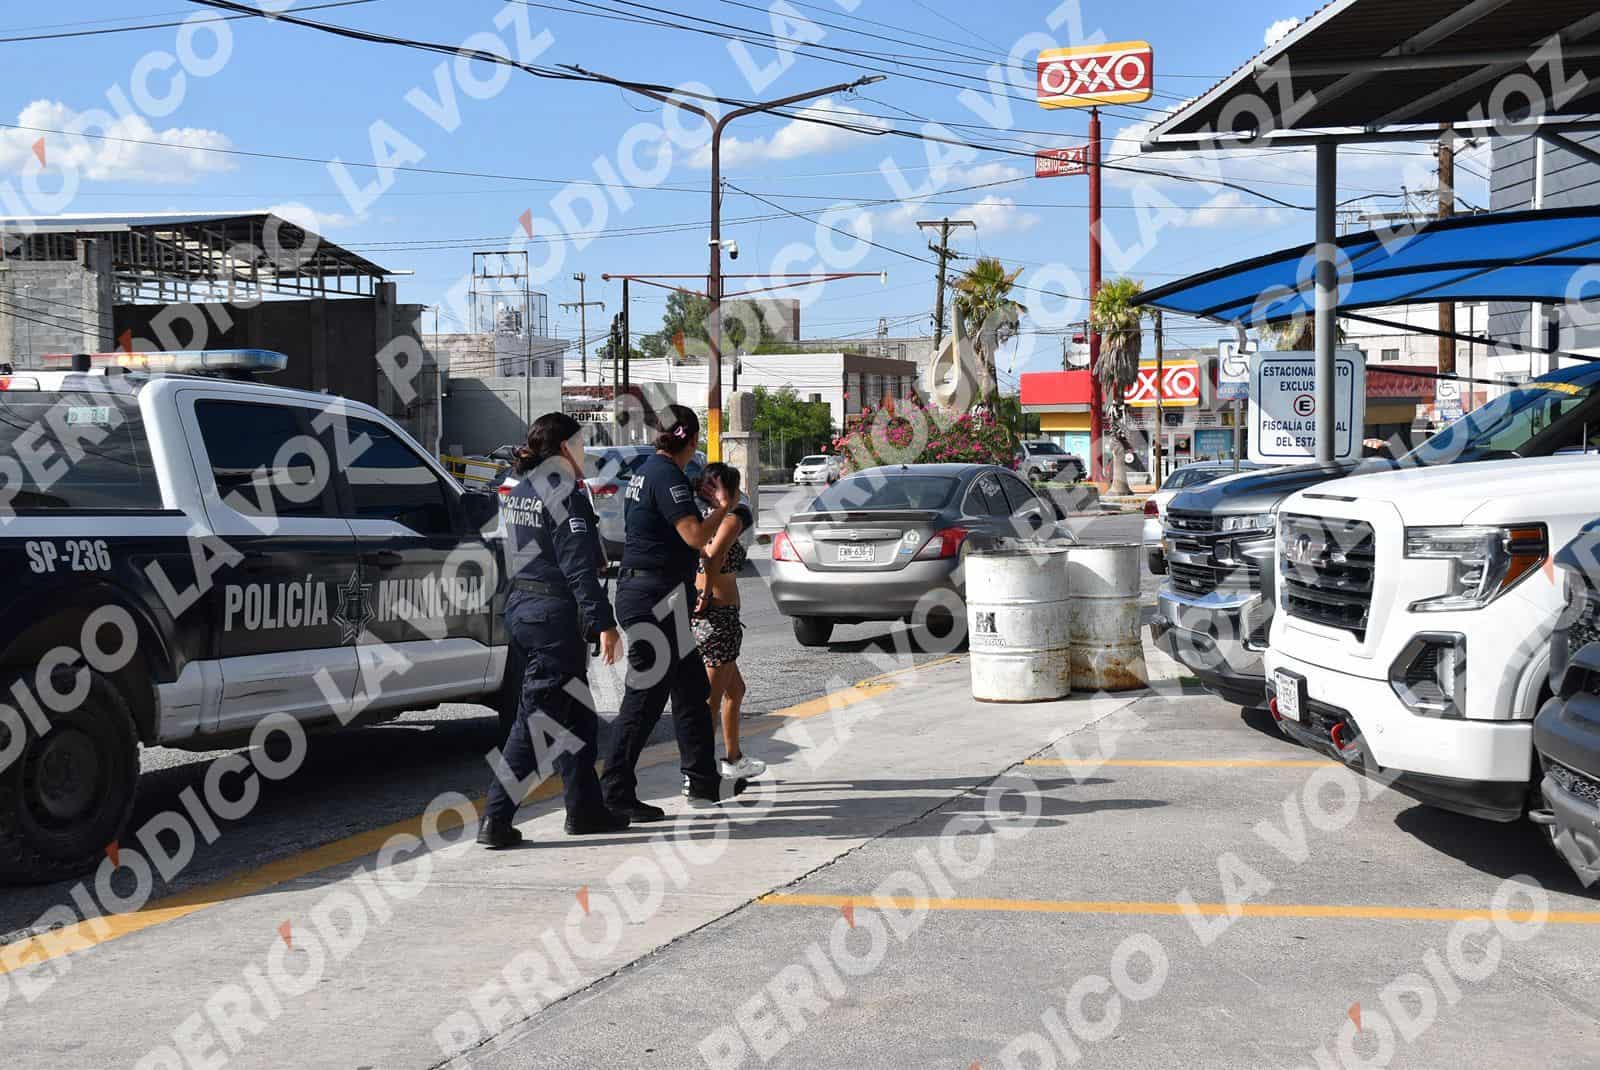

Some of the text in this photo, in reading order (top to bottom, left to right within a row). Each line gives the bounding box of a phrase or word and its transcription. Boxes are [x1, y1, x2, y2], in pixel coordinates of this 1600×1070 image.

[1041, 54, 1145, 95] OXXO
[1263, 366, 1349, 377] ESTACIONATO
[1280, 381, 1316, 392] EXCLUS
[571, 412, 609, 422] COPIAS
[1305, 421, 1348, 432] GEAL
[1276, 437, 1316, 447] DEL ESTA
[25, 540, 112, 573] SP-236
[224, 573, 490, 631] POLICÍA MUNICIPAL
